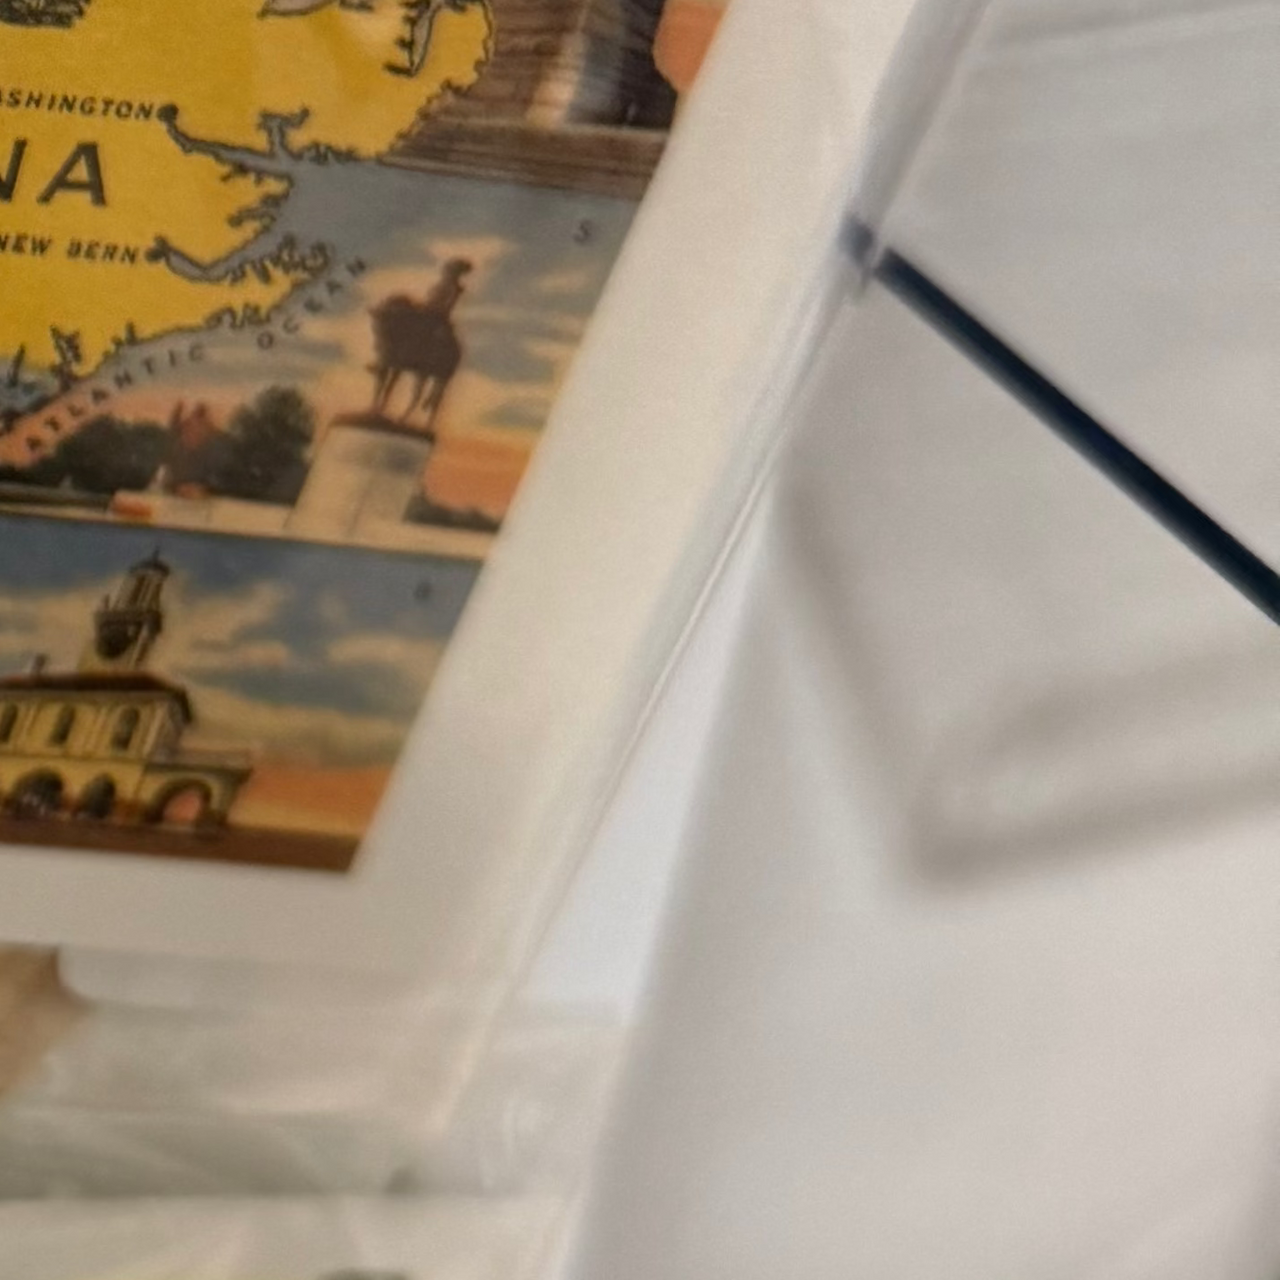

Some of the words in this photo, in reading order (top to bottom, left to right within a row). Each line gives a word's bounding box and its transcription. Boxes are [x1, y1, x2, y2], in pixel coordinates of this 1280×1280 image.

[67, 239, 141, 266] BERN
[26, 346, 208, 455] ATLANTIC
[257, 258, 366, 350] OCEAN
